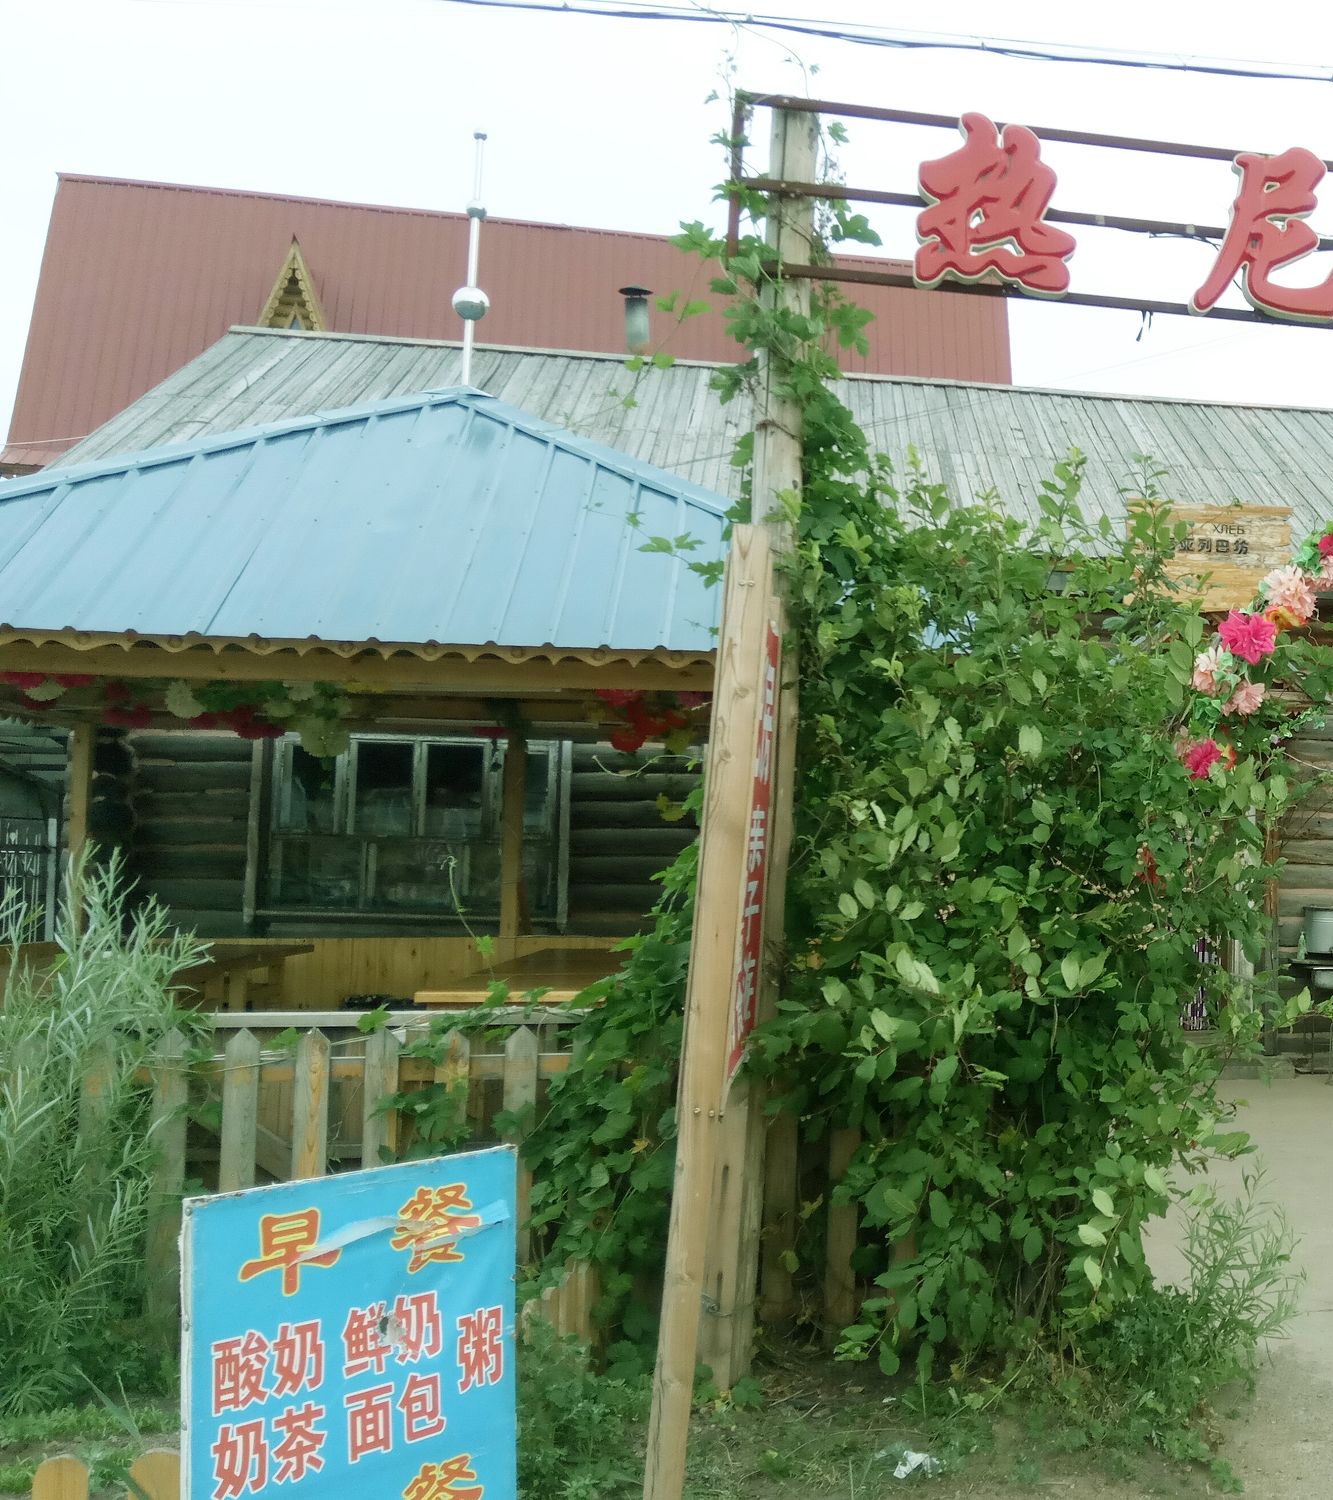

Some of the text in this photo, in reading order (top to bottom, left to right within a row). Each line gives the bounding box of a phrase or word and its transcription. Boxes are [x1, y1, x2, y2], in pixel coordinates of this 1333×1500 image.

[239, 1183, 481, 1296] 早餐
[211, 1290, 503, 1416] 酸奶 鲜奶 粥
[211, 1373, 446, 1500] 奶茶 面包
